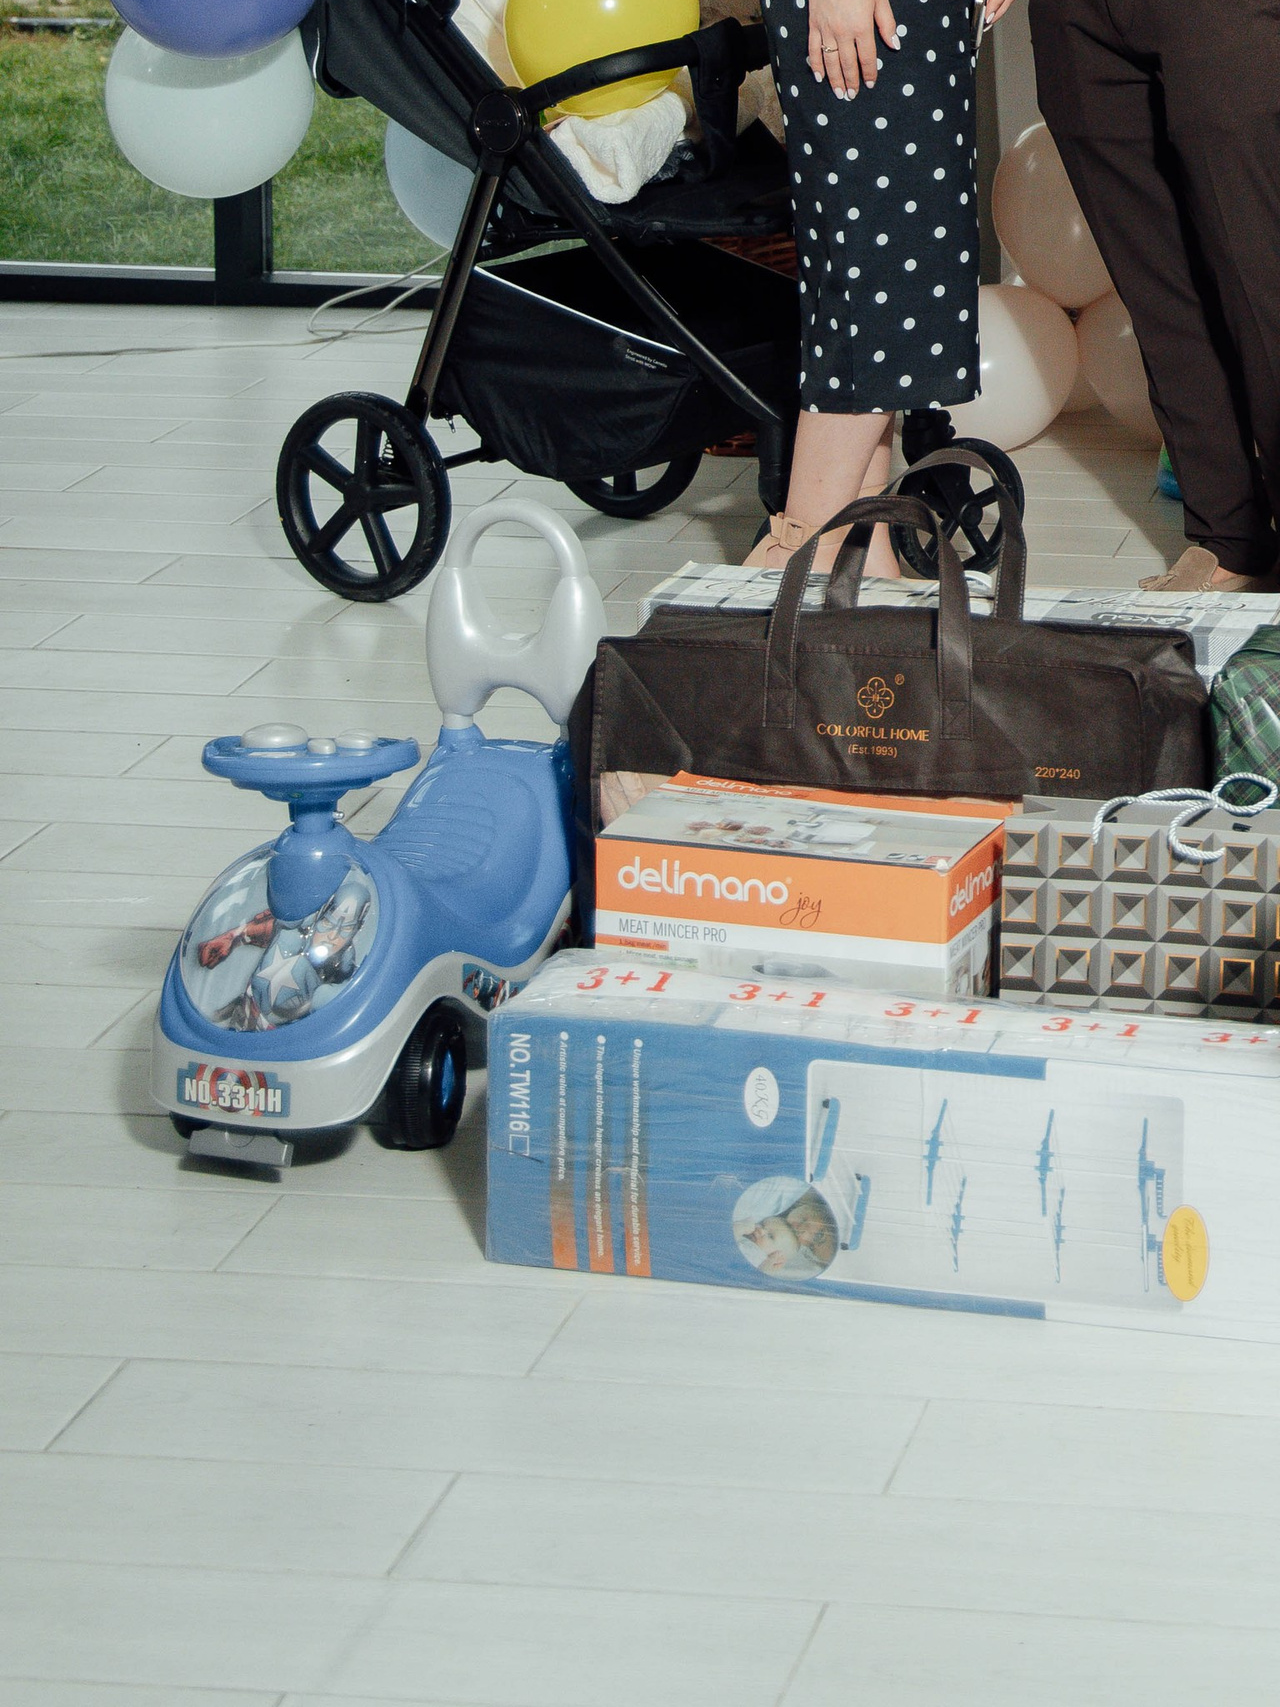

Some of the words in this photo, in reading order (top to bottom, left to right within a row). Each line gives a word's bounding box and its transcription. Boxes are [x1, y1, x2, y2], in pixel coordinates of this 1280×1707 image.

[816, 723, 888, 741] COLORFUL
[890, 728, 930, 742] HOME
[847, 744, 898, 759] (Est.1993)
[696, 778, 792, 796] delimano
[617, 855, 789, 905] delimano
[779, 891, 822, 929] joy
[618, 917, 650, 935] MEAT
[653, 921, 699, 941] MINCER
[703, 926, 728, 943] PRO
[577, 967, 673, 993] 3+1
[728, 983, 827, 1008] 3+1
[884, 1002, 984, 1025] 3+1
[1041, 1016, 1141, 1038] 3+1
[559, 1040, 568, 1072] Artistic
[596, 1045, 605, 1061] The
[631, 1048, 641, 1079] Unique
[509, 1032, 532, 1132] NO.TW116
[559, 1073, 568, 1096] value
[595, 1062, 604, 1094] elegant
[183, 1076, 282, 1113] NO.3311H
[559, 1097, 567, 1107] at
[596, 1095, 604, 1126] clothes
[630, 1080, 641, 1136] workmanship
[558, 1107, 567, 1156] competitive
[594, 1127, 604, 1156] hanger
[632, 1138, 640, 1154] and
[556, 1157, 566, 1181] price.
[630, 1155, 639, 1191] material
[594, 1191, 602, 1202] an
[630, 1191, 639, 1204] for
[594, 1203, 603, 1232] elegant
[631, 1205, 640, 1235] durable
[633, 1236, 642, 1266] service.
